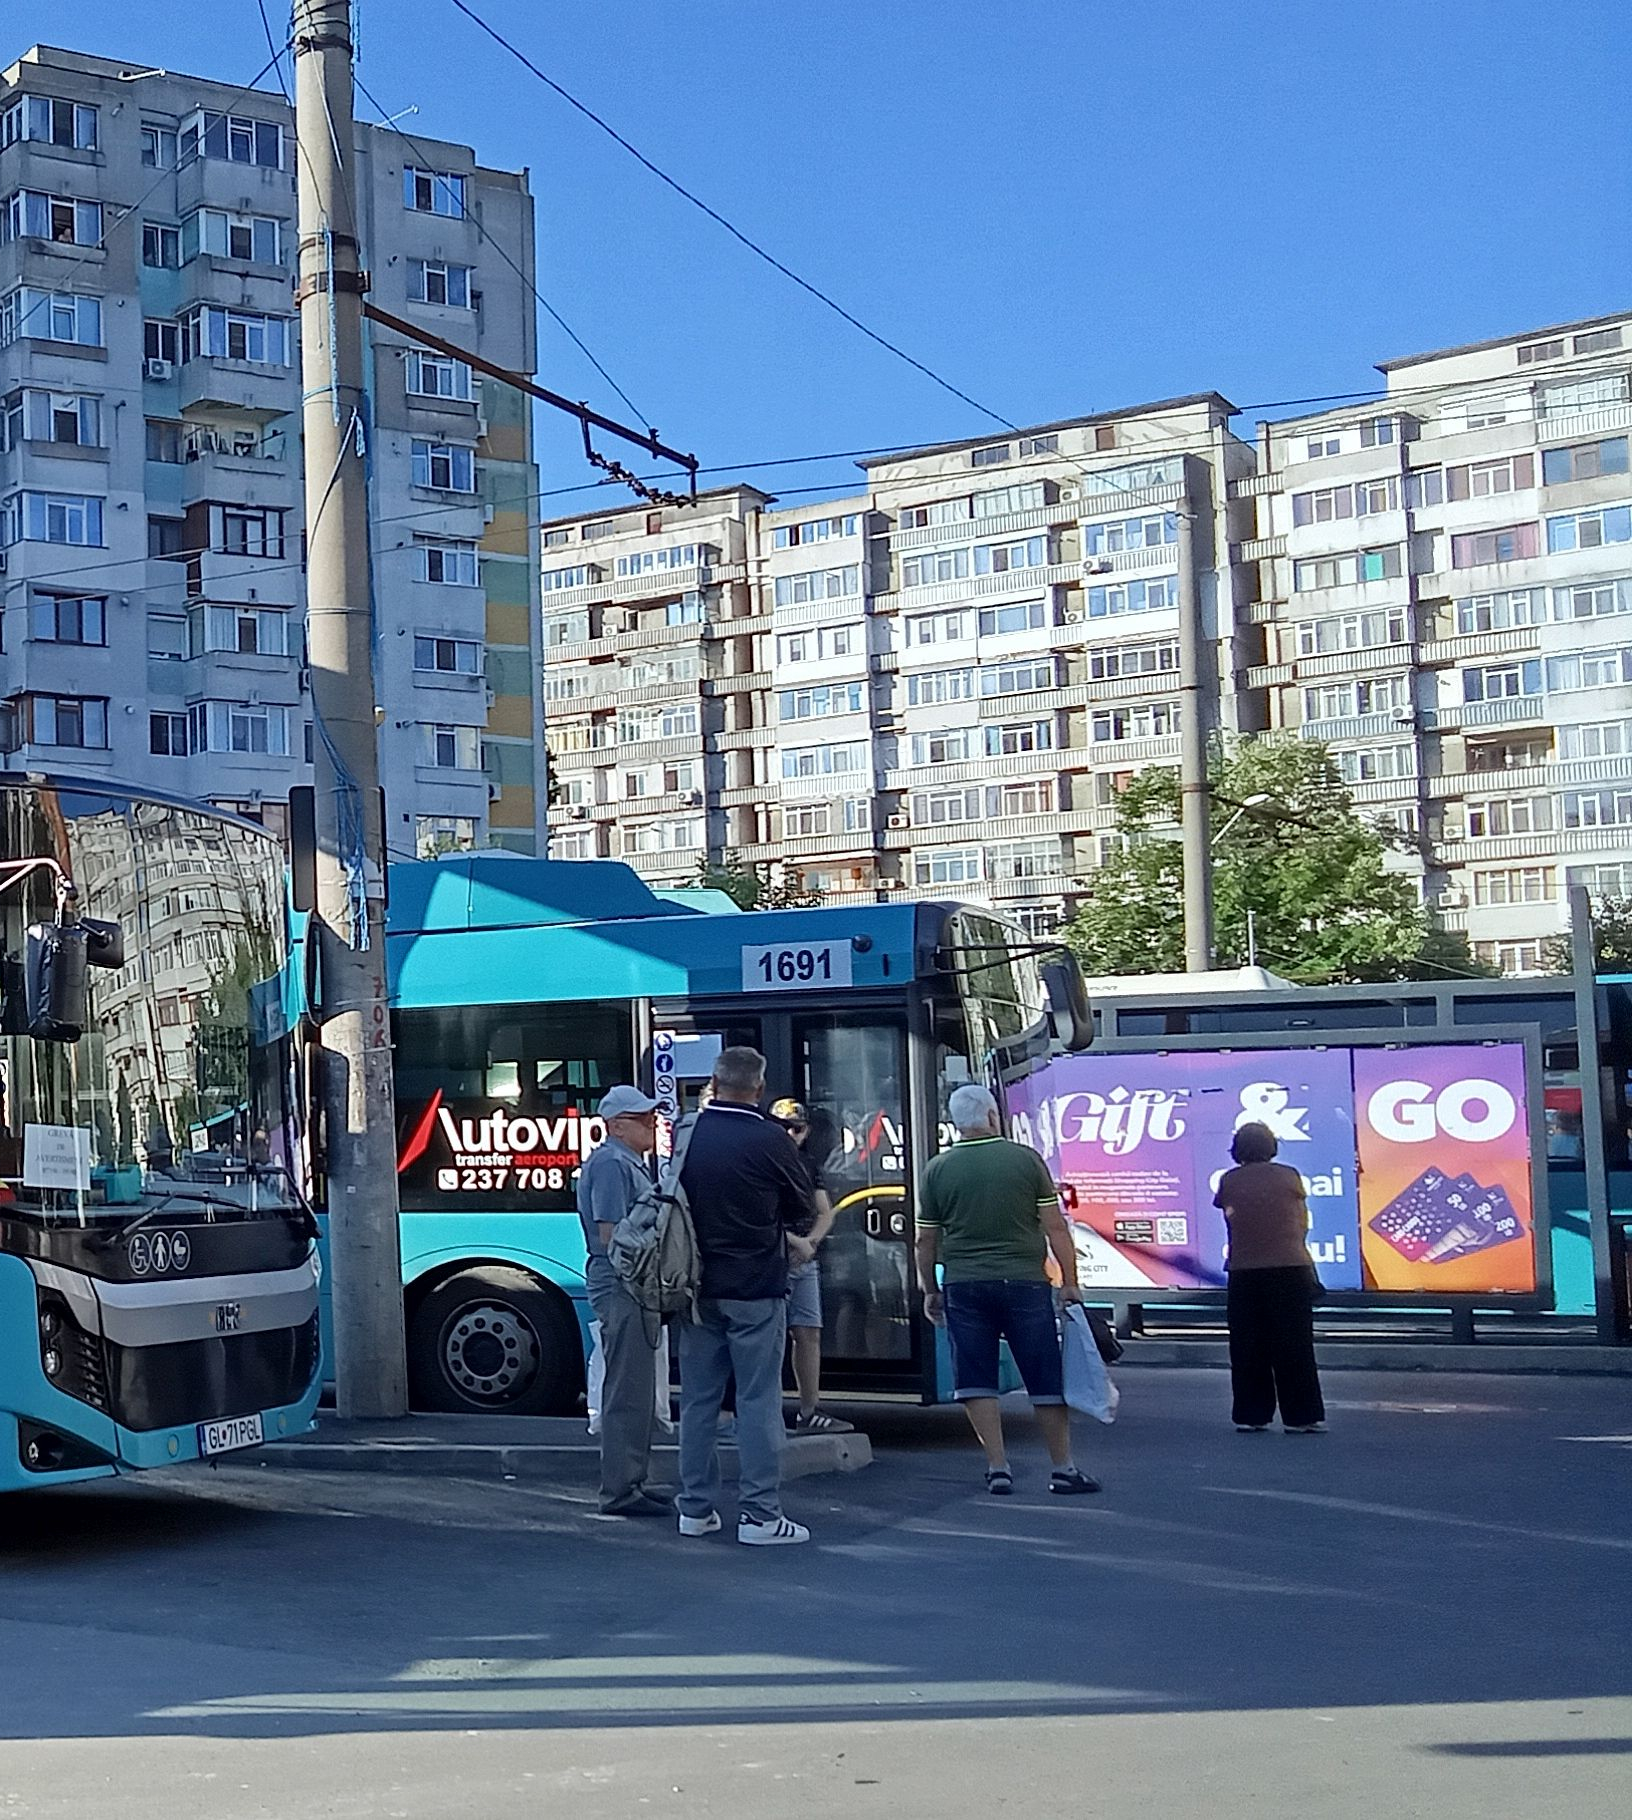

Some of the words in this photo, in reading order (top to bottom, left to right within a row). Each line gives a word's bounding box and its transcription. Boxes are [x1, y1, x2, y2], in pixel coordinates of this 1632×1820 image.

[758, 948, 831, 982] 1691
[1055, 1085, 1189, 1156] Gift
[1368, 1078, 1516, 1142] GO
[455, 1153, 514, 1167] transfer
[514, 1154, 580, 1170] aeroport
[462, 1169, 508, 1190] 237
[515, 1169, 564, 1190] 708
[1472, 1202, 1492, 1219] 100
[1494, 1217, 1516, 1232] 200
[208, 1426, 225, 1449] GL
